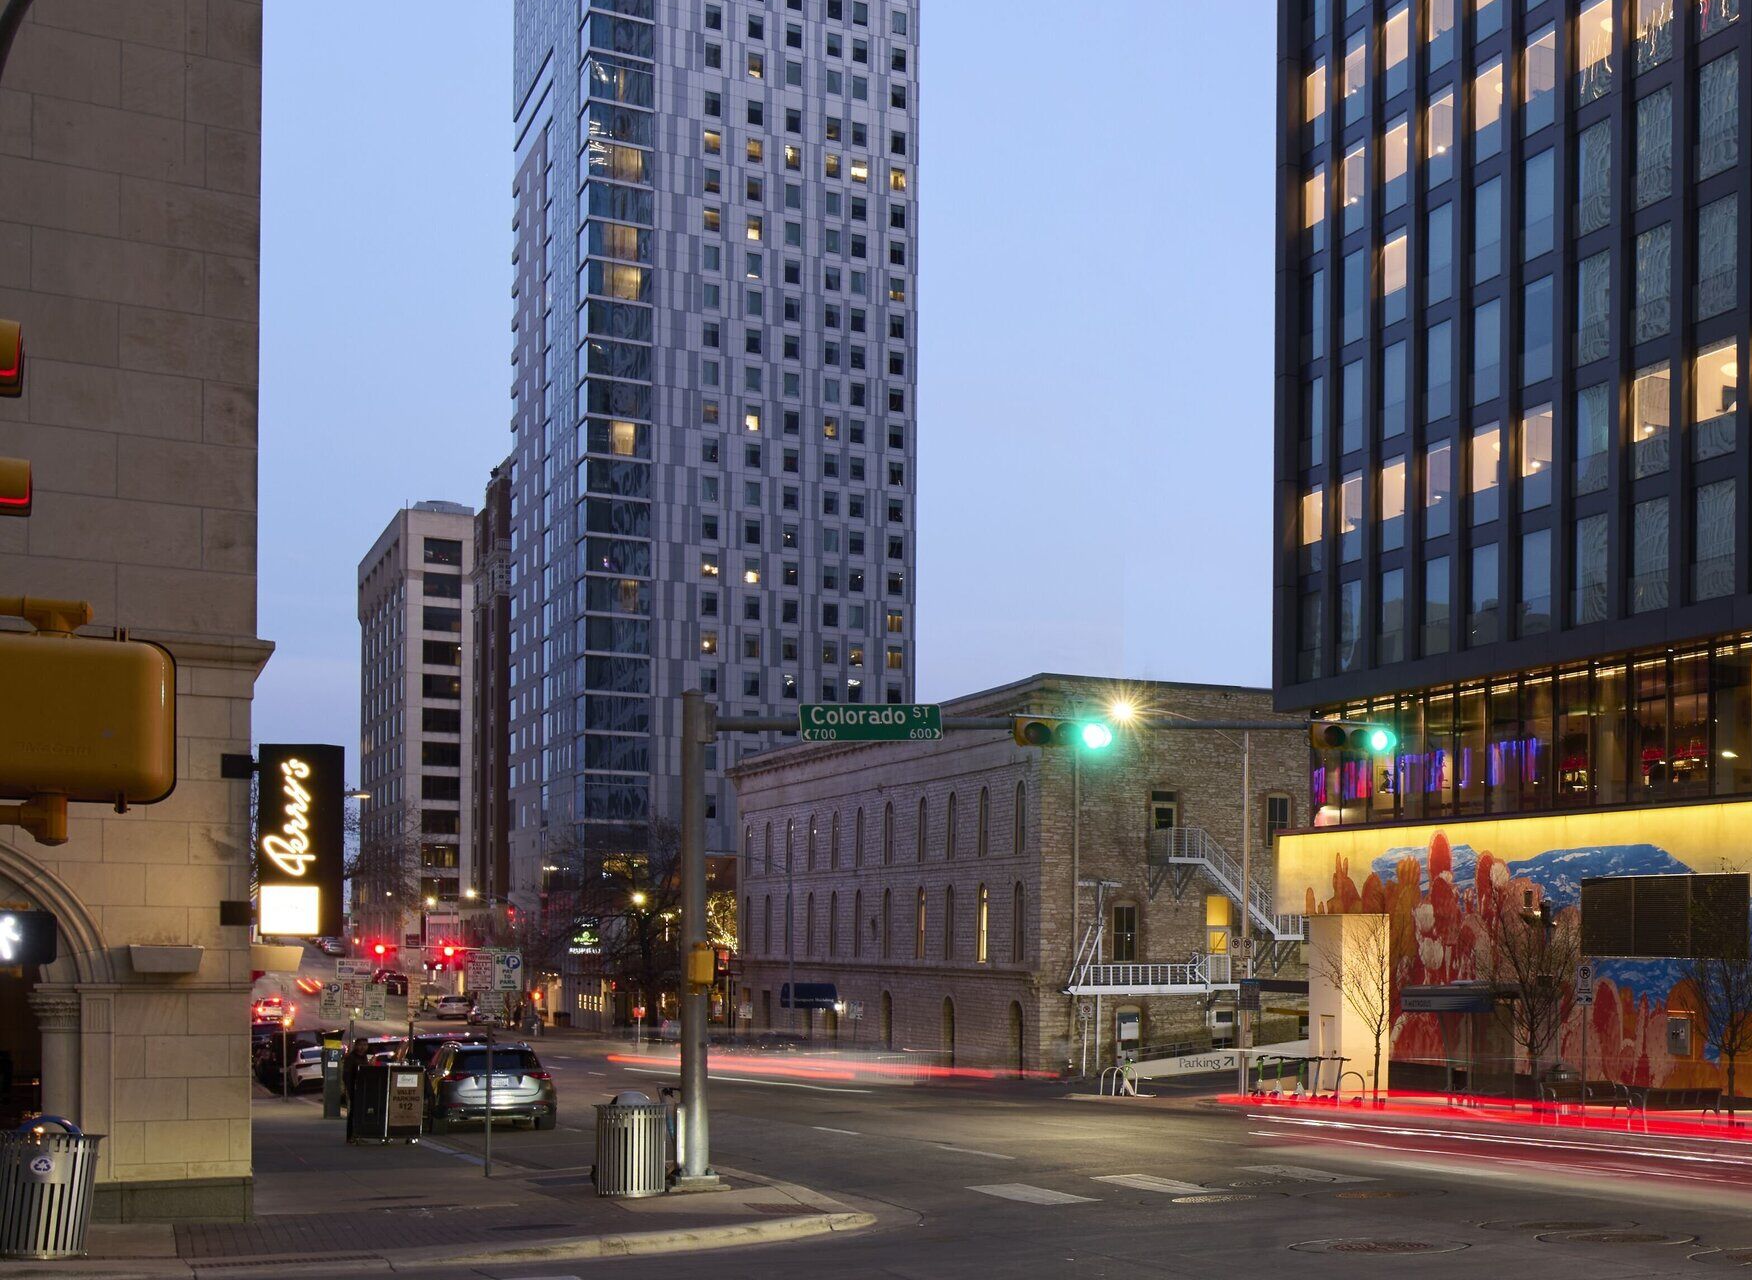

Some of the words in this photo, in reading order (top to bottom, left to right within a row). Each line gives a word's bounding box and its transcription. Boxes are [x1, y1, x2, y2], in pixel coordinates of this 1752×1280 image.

[811, 706, 906, 725] Colorado
[912, 706, 930, 718] ST
[814, 728, 837, 740] 700
[909, 728, 932, 739] 600
[1179, 1056, 1221, 1069] Parking
